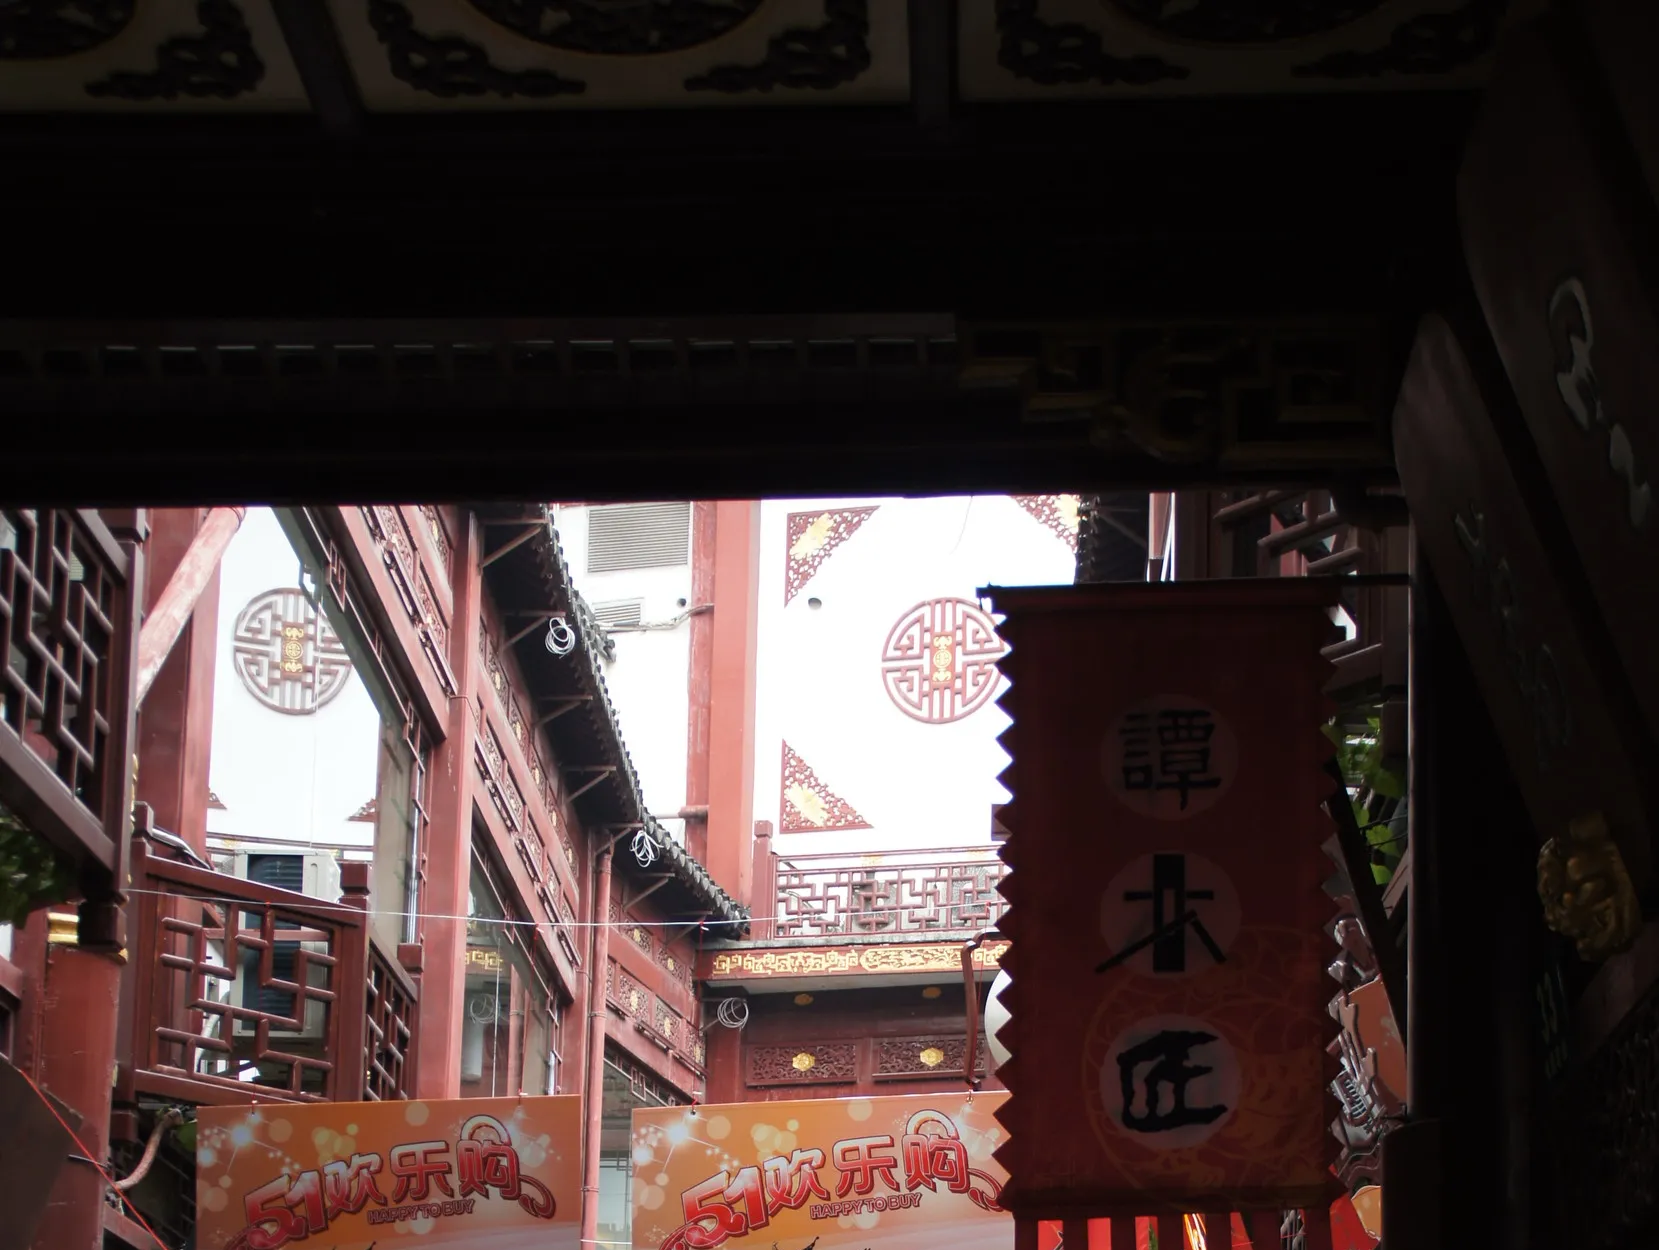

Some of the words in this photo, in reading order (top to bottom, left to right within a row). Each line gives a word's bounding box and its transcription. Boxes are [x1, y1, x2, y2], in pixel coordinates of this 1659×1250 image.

[1096, 708, 1229, 1134] 譚木匠
[368, 1205, 420, 1225] HAPPY
[420, 1203, 441, 1218] TO
[441, 1199, 475, 1216] BUY
[810, 1200, 862, 1219] HAPPY
[863, 1197, 887, 1212] TO
[887, 1193, 922, 1210] BUY
